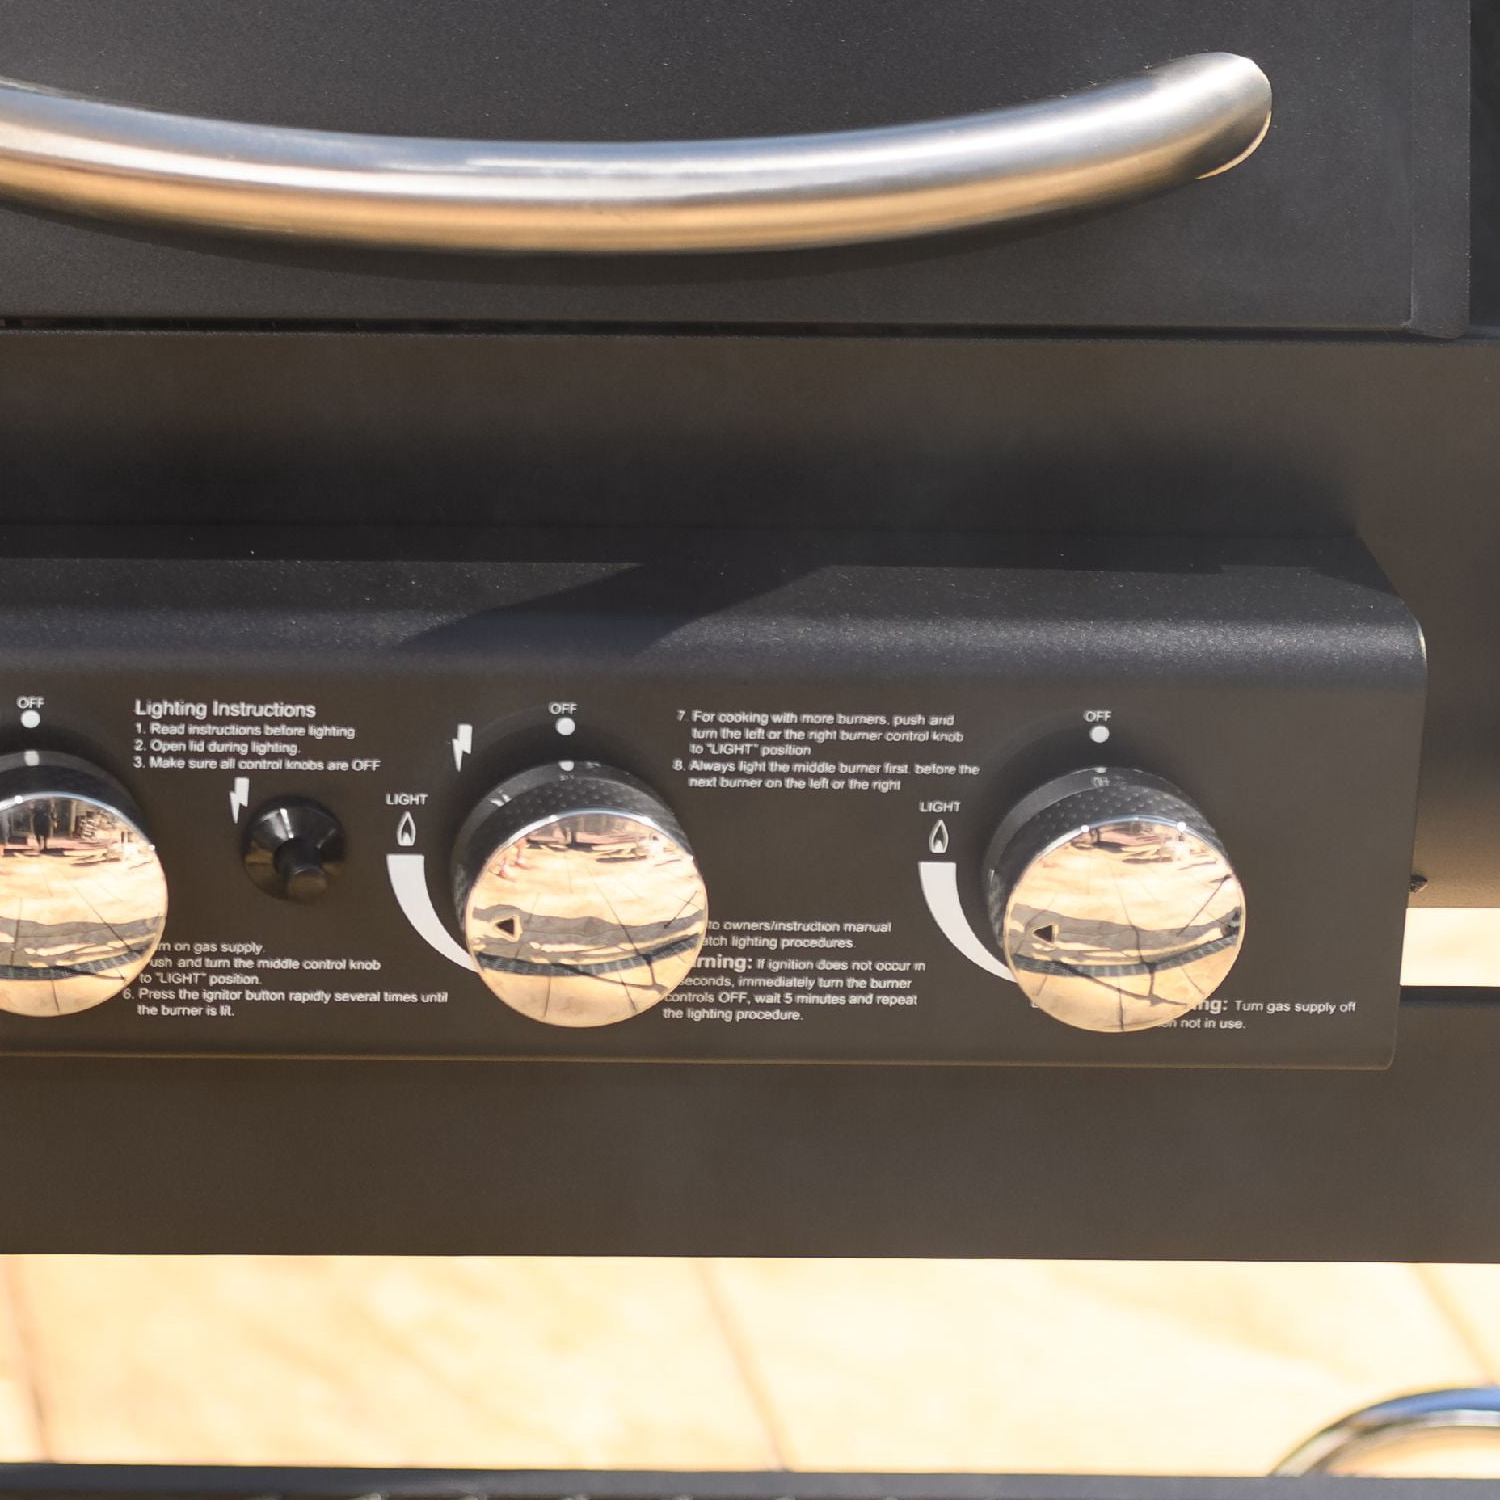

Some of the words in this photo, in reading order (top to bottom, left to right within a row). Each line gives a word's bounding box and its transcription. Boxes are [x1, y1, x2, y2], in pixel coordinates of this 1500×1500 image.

[16, 696, 44, 709] OFF
[134, 699, 207, 720] Lighting
[212, 700, 316, 718] Instructions
[548, 702, 577, 714] OFF
[1083, 709, 1111, 722] OFF
[149, 722, 185, 735] Read
[187, 723, 262, 736] instructions
[263, 724, 306, 736] before
[307, 724, 355, 740] lighting
[149, 738, 186, 754] Open
[188, 739, 204, 752] lid
[206, 740, 248, 755] during
[149, 755, 185, 769] Make
[187, 759, 217, 769] sure
[219, 757, 235, 770] all
[237, 758, 282, 770] control
[284, 759, 324, 770] knobs
[326, 760, 348, 771] are
[351, 758, 381, 772] OFF
[688, 776, 717, 787] next
[718, 776, 763, 788] burner
[764, 778, 782, 788] on
[784, 777, 806, 789] the
[808, 776, 828, 789] left
[830, 780, 845, 790] or
[847, 778, 869, 790] the
[871, 779, 900, 793] right
[385, 793, 428, 805] LIGHT
[919, 800, 960, 812] LIGHT
[1235, 1000, 1263, 1011] Turn
[1266, 1002, 1290, 1014] gas
[1294, 1001, 1336, 1014] supply
[1339, 1001, 1355, 1013] off
[663, 1007, 683, 1019] the
[686, 1007, 732, 1022] lighting
